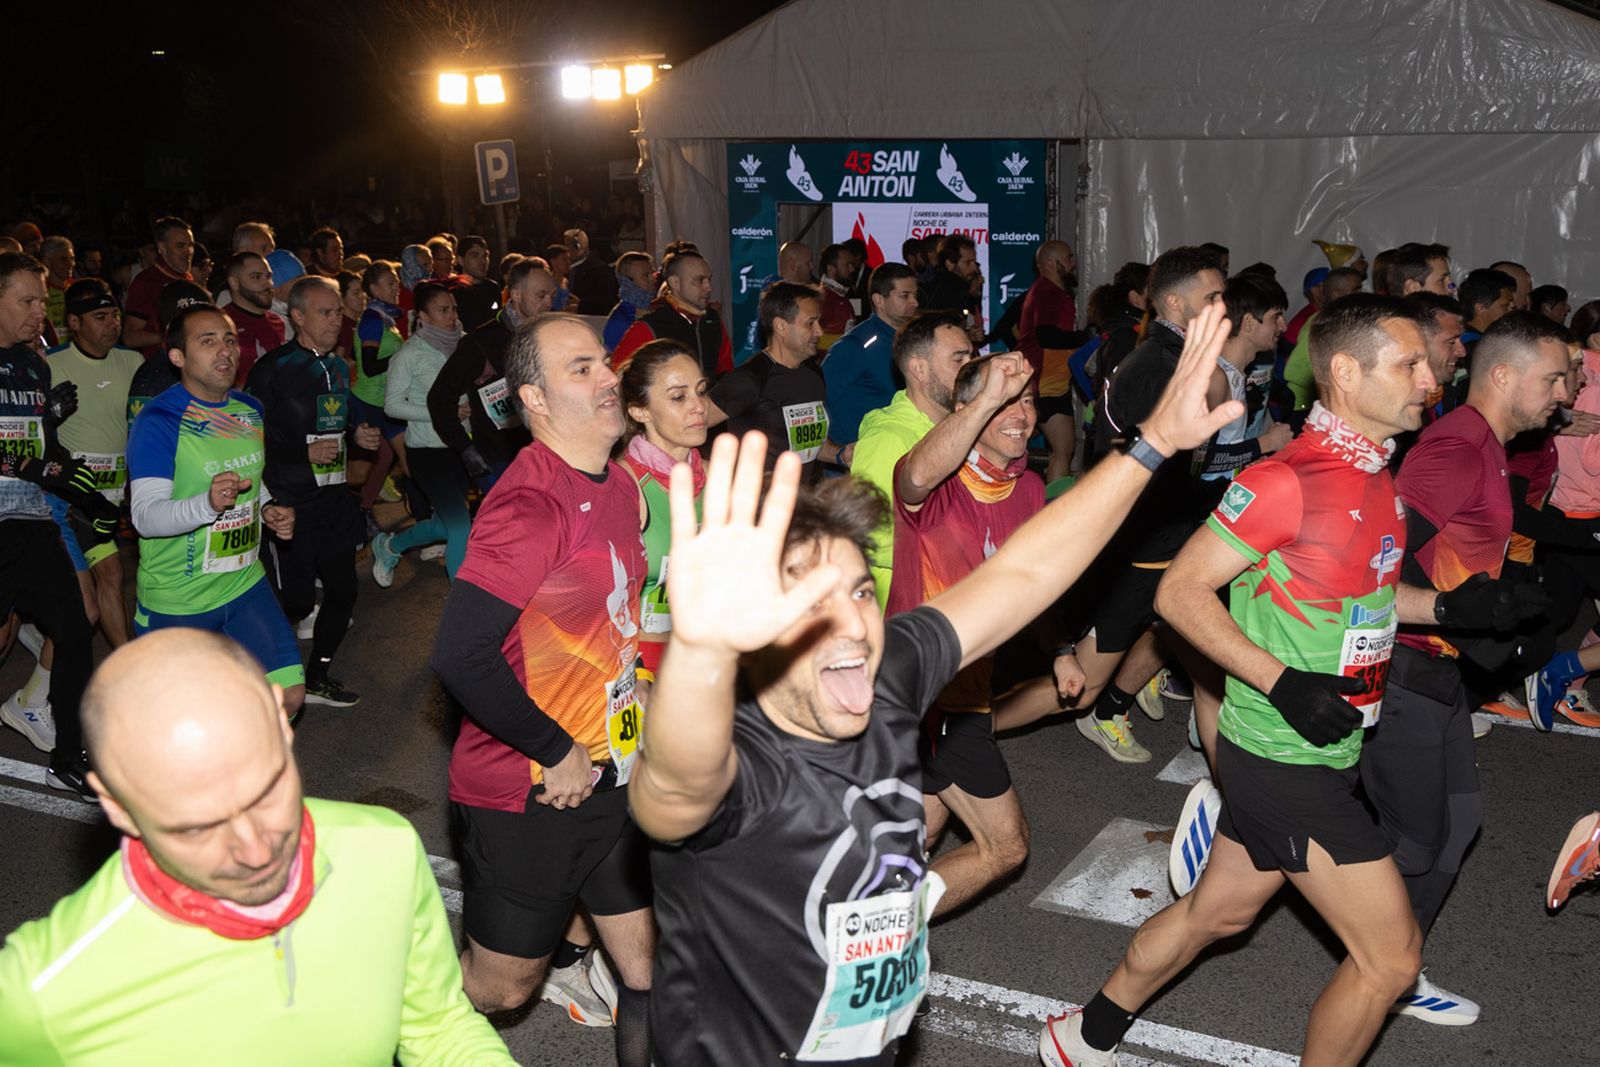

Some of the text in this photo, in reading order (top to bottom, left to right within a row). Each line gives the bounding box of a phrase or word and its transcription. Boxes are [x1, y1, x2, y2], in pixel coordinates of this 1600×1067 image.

[485, 149, 509, 196] P
[837, 169, 916, 197] ANTÓN
[797, 176, 811, 192] 43
[948, 176, 964, 192] 43
[796, 422, 823, 445] 8982
[1353, 653, 1372, 665] SAN
[862, 913, 907, 934] NOCHE
[845, 938, 872, 962] SAN
